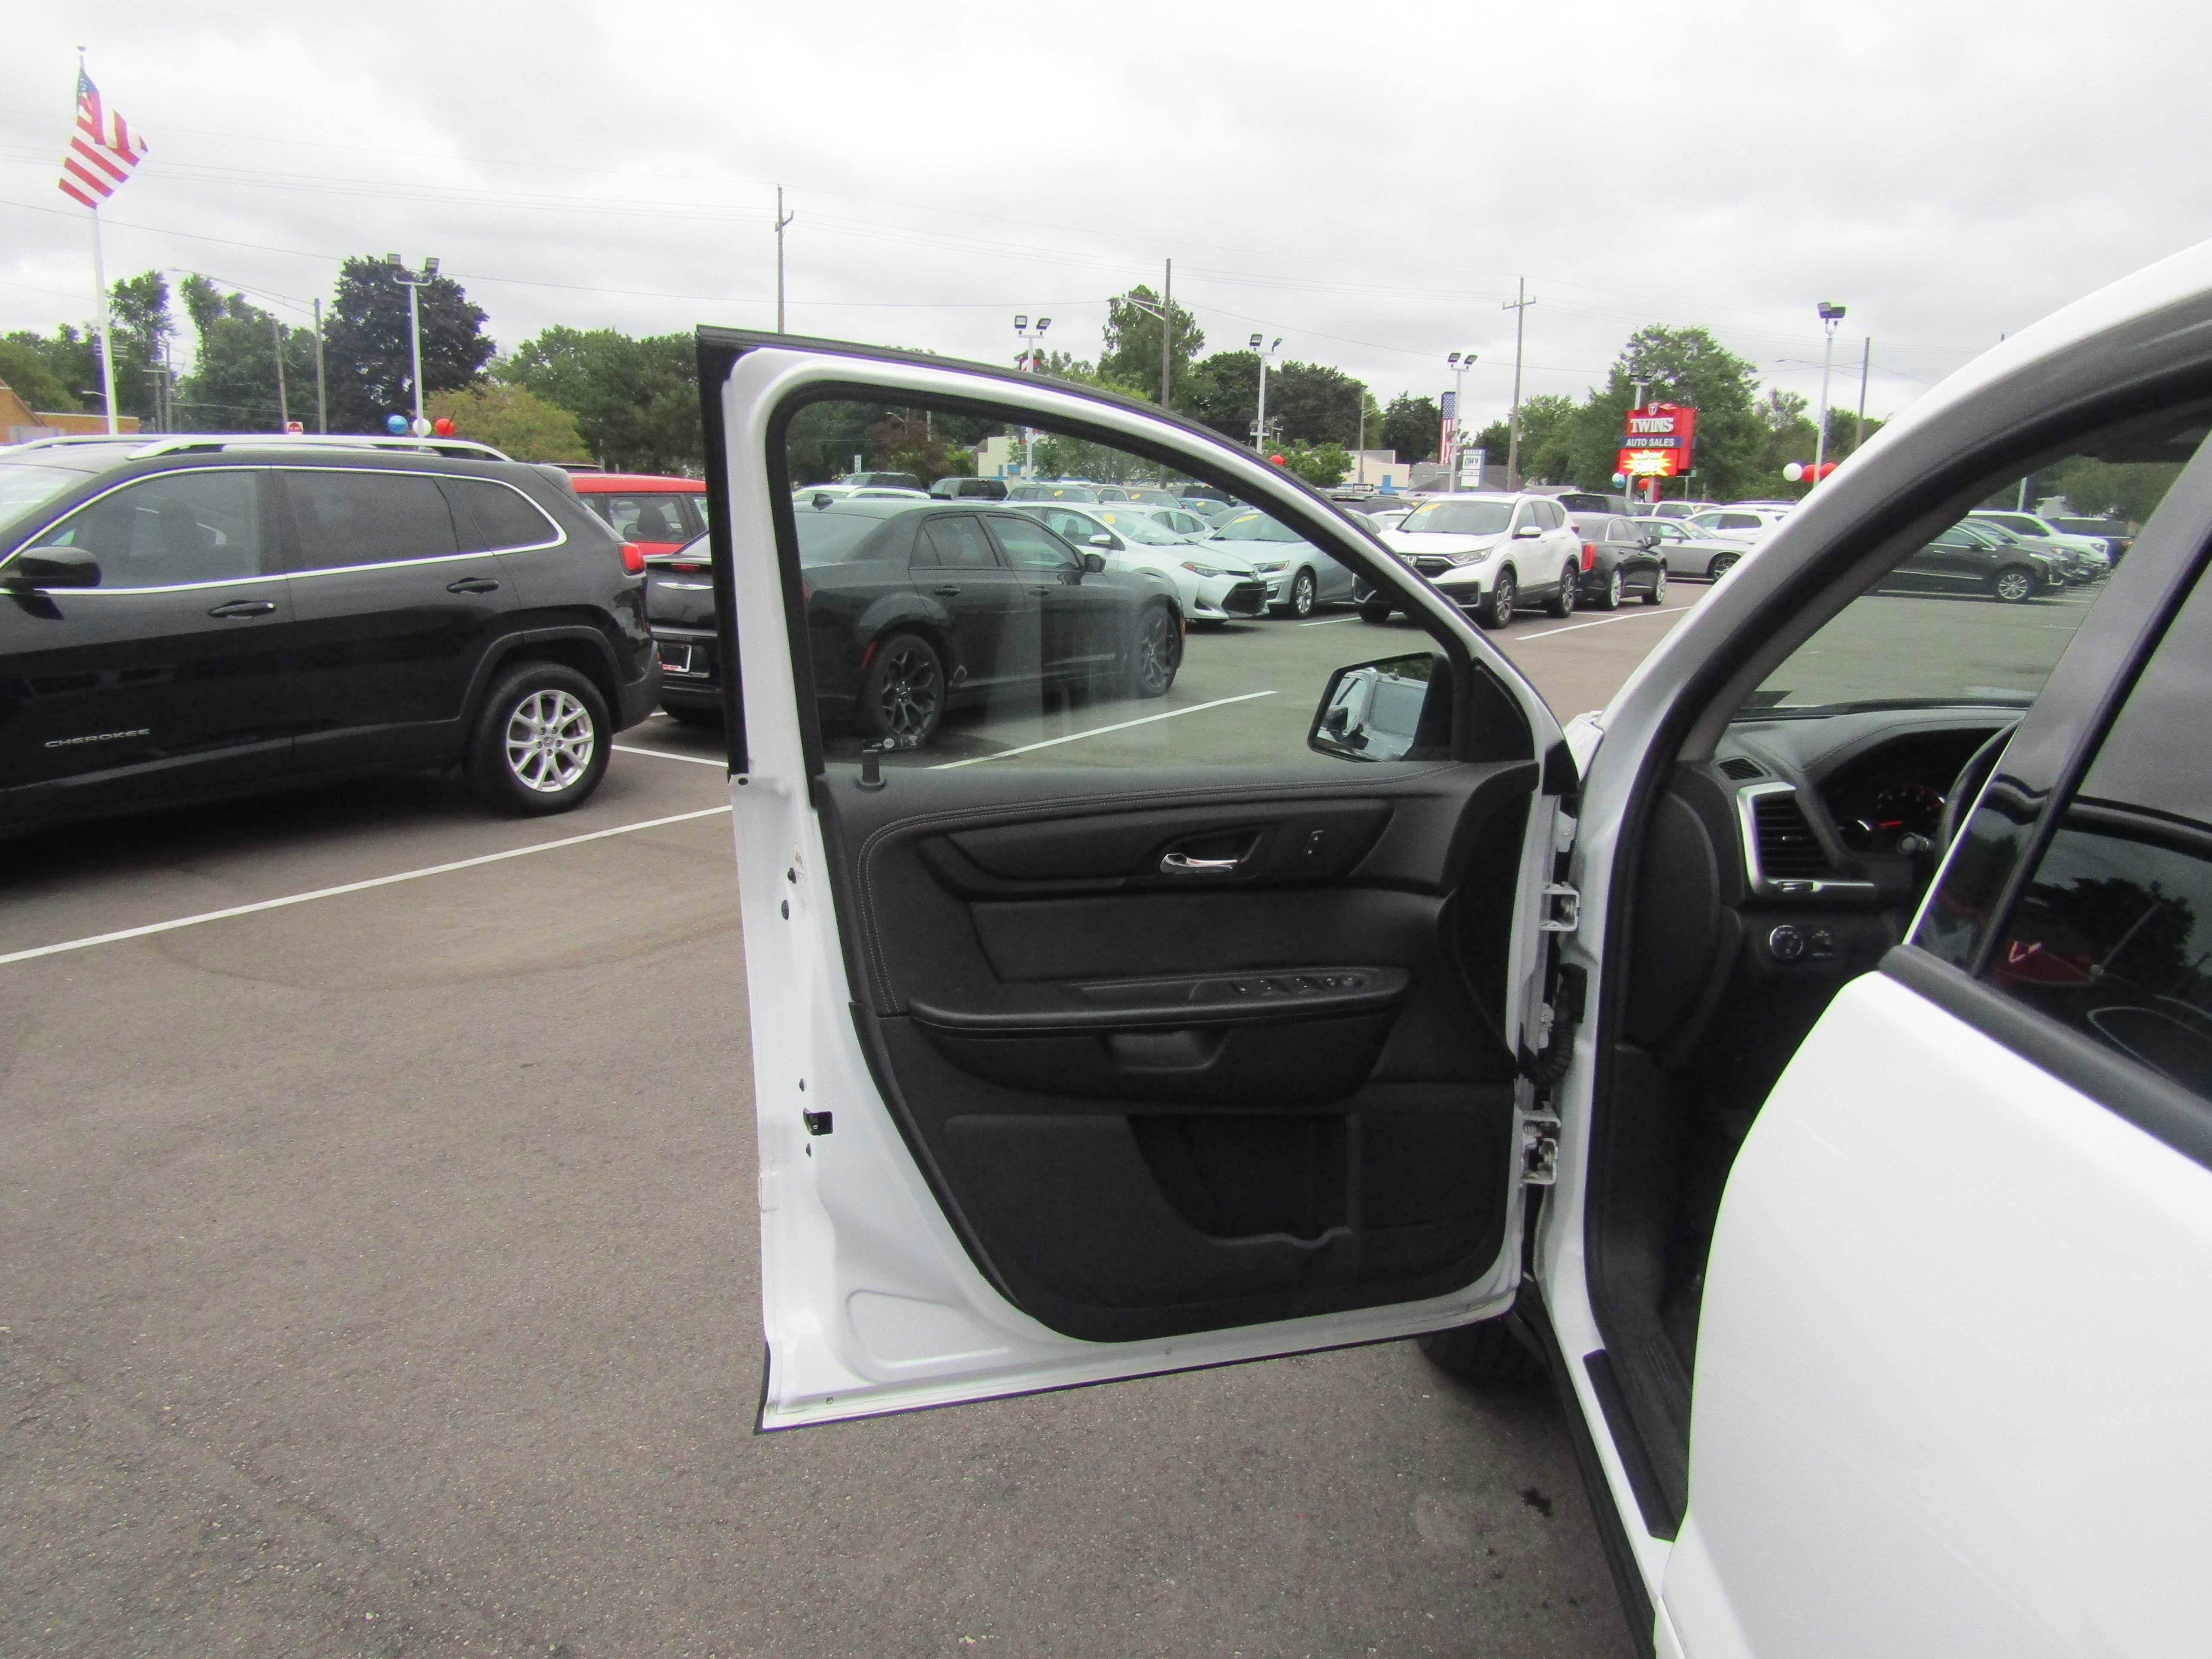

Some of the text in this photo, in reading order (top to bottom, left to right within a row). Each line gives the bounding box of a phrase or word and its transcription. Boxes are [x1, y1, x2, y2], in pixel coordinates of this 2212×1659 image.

[1630, 418, 1674, 433] TWINS
[1626, 438, 1674, 447] AUTO SALES
[45, 729, 150, 747] CHEROKEE
